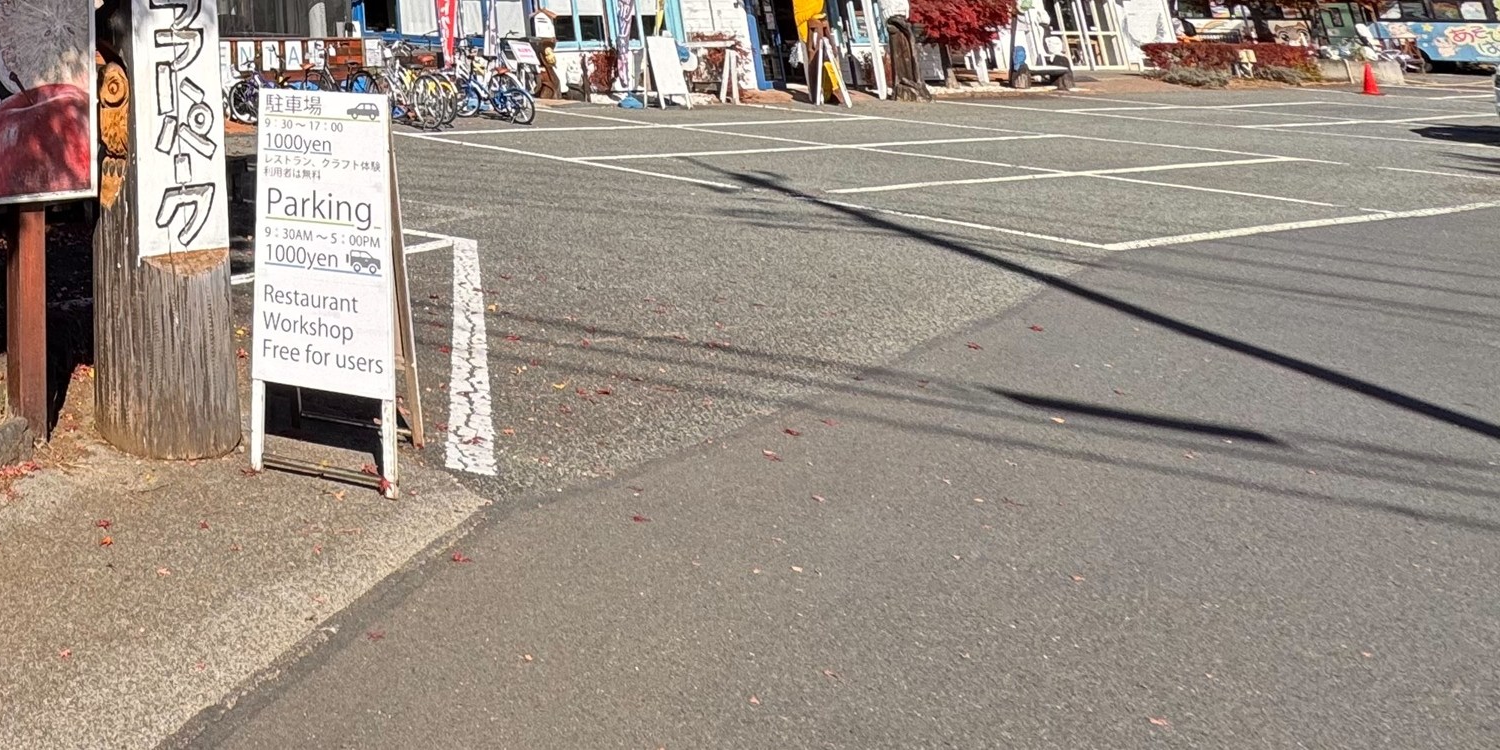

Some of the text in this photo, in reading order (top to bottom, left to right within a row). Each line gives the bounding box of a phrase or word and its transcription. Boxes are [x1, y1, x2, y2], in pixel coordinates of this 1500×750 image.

[266, 94, 322, 116] 駐車場
[266, 132, 332, 155] 1000yen
[264, 166, 321, 180] 利用者は無料
[268, 187, 371, 231] Parking
[266, 243, 338, 270] 1000yen
[264, 284, 358, 314] Restaurant
[263, 311, 354, 345] Workshop
[263, 338, 384, 374] Free for users
